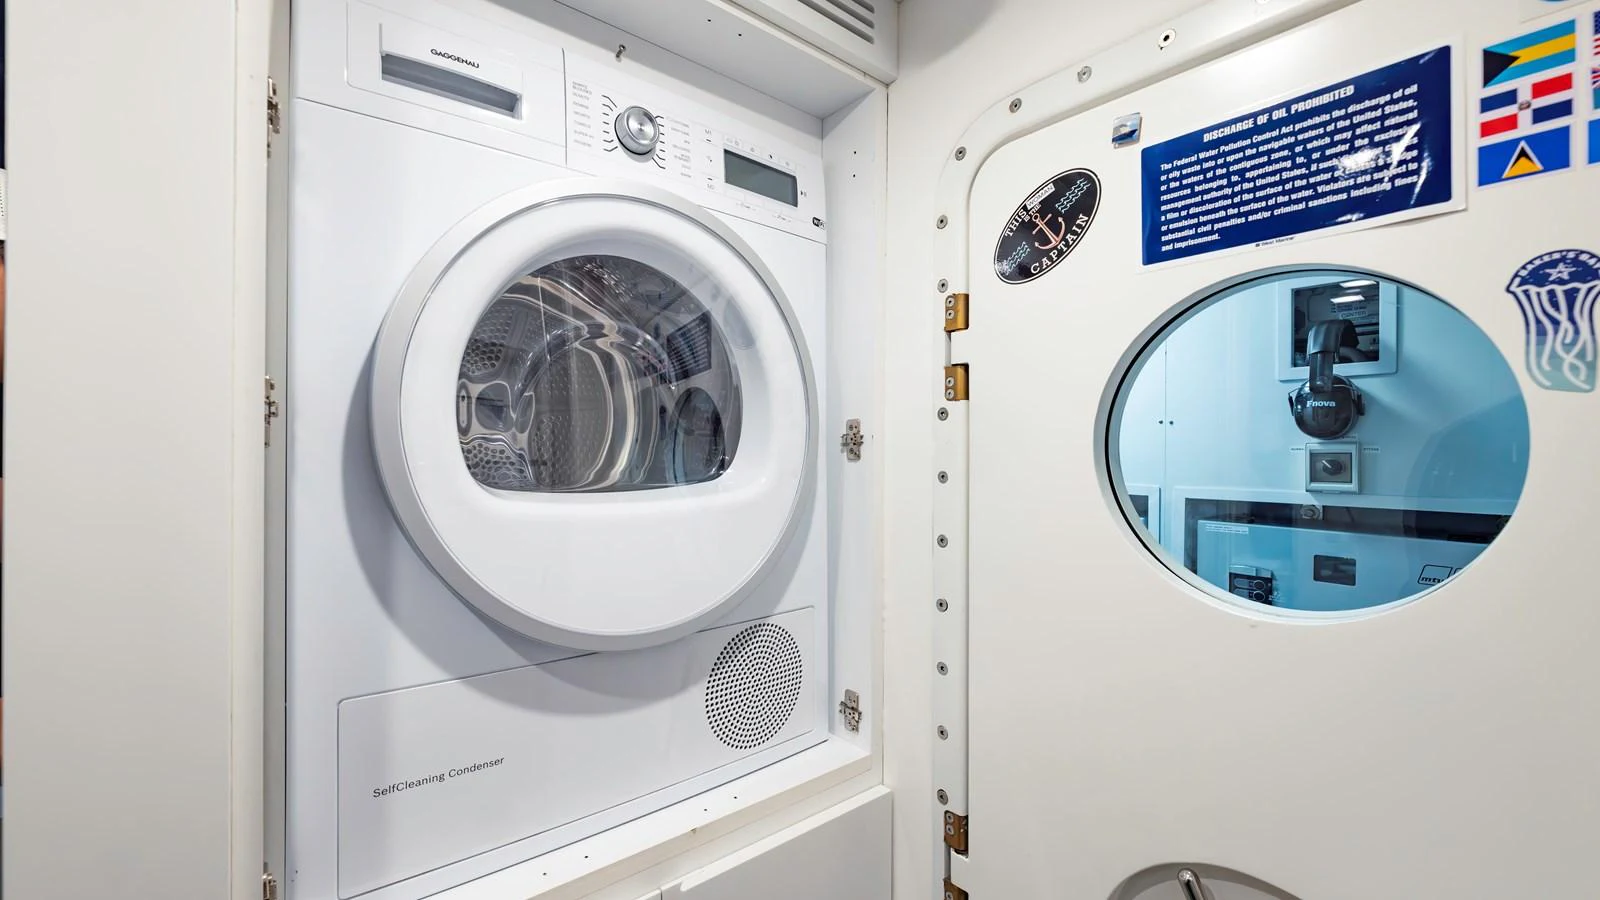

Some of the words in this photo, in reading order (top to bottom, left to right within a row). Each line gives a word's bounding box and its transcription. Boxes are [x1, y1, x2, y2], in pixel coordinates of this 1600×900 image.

[430, 48, 480, 69] GAGGENAU
[1160, 163, 1172, 171] The
[1173, 153, 1197, 167] Federal
[1198, 148, 1219, 159] Water
[1219, 138, 1251, 153] Pollution
[1252, 128, 1279, 143] Control
[1280, 124, 1293, 134] Act
[1294, 113, 1330, 131] prohibits
[1331, 108, 1346, 118] the
[1347, 93, 1391, 113] discharge
[1392, 88, 1403, 99] of
[1403, 83, 1418, 95] oil
[1168, 170, 1180, 179] oily
[1181, 164, 1201, 175] waste
[1202, 160, 1216, 169] into
[1216, 157, 1225, 165] or
[1225, 151, 1243, 162] upon
[1244, 147, 1257, 156] the
[1258, 136, 1295, 152] navigable
[1296, 127, 1324, 140] waters
[1326, 122, 1335, 132] of
[1336, 119, 1350, 129] the
[1352, 107, 1382, 123] United
[1383, 99, 1417, 114] States,
[1203, 117, 1254, 142] DISCHARGE
[1256, 112, 1269, 125] OF
[1271, 107, 1288, 120] OIL
[1290, 84, 1354, 114] PROHIBITED
[1160, 188, 1191, 201] resources
[1194, 178, 1227, 192] belonging
[1244, 159, 1292, 178] appertaining
[1295, 156, 1307, 164] to,
[1311, 151, 1321, 159] or
[1325, 143, 1350, 156] under
[1354, 137, 1369, 147] the
[1181, 174, 1204, 185] waters
[1206, 170, 1213, 178] of
[1215, 167, 1227, 176] the
[1229, 155, 1268, 172] contiguous
[1270, 149, 1291, 160] zone,
[1294, 144, 1304, 153] or
[1306, 136, 1331, 149] which
[1333, 130, 1352, 141] may
[1355, 120, 1381, 135] affect
[1384, 109, 1418, 126] natural
[1005, 208, 1028, 238] THIS
[1027, 185, 1054, 208] WOMAN
[1028, 203, 1042, 217] THE
[1160, 194, 1202, 211] management
[1202, 187, 1232, 200] authority
[1233, 183, 1241, 192] of
[1242, 181, 1254, 190] the
[1255, 173, 1280, 186] United
[1281, 167, 1309, 179] States,
[1310, 162, 1317, 171] if
[1318, 157, 1338, 169] such
[1161, 227, 1195, 241] substantial
[1197, 223, 1212, 233] civil
[1213, 216, 1245, 231] penalties
[1247, 210, 1271, 221] and/or
[1273, 201, 1306, 215] criminal
[1308, 192, 1348, 207] sanctions
[1350, 180, 1392, 197] including
[1394, 174, 1419, 187] fines
[1166, 212, 1179, 220] film
[1188, 198, 1232, 214] discoloration
[1233, 194, 1241, 203] of
[1241, 192, 1254, 201] the
[1255, 185, 1283, 197] surface
[1284, 181, 1293, 190] of
[1294, 178, 1307, 187] the
[1308, 171, 1332, 183] water
[1168, 217, 1198, 229] emulsion
[1199, 210, 1226, 222] beneath
[1226, 207, 1238, 215] the
[1239, 200, 1266, 212] surface
[1267, 197, 1275, 205] of
[1276, 195, 1289, 203] the
[1290, 188, 1315, 200] water.
[1316, 178, 1355, 193] Violators
[1356, 174, 1371, 184] are
[1372, 164, 1406, 180] subject
[1407, 162, 1418, 170] to
[1030, 213, 1089, 274] CAPTAIN
[1161, 242, 1173, 251] and
[1174, 233, 1221, 249] imprisonment.
[1306, 400, 1336, 408] Fnova
[372, 773, 447, 798] SelfCleaning
[448, 757, 506, 779] Condenser
